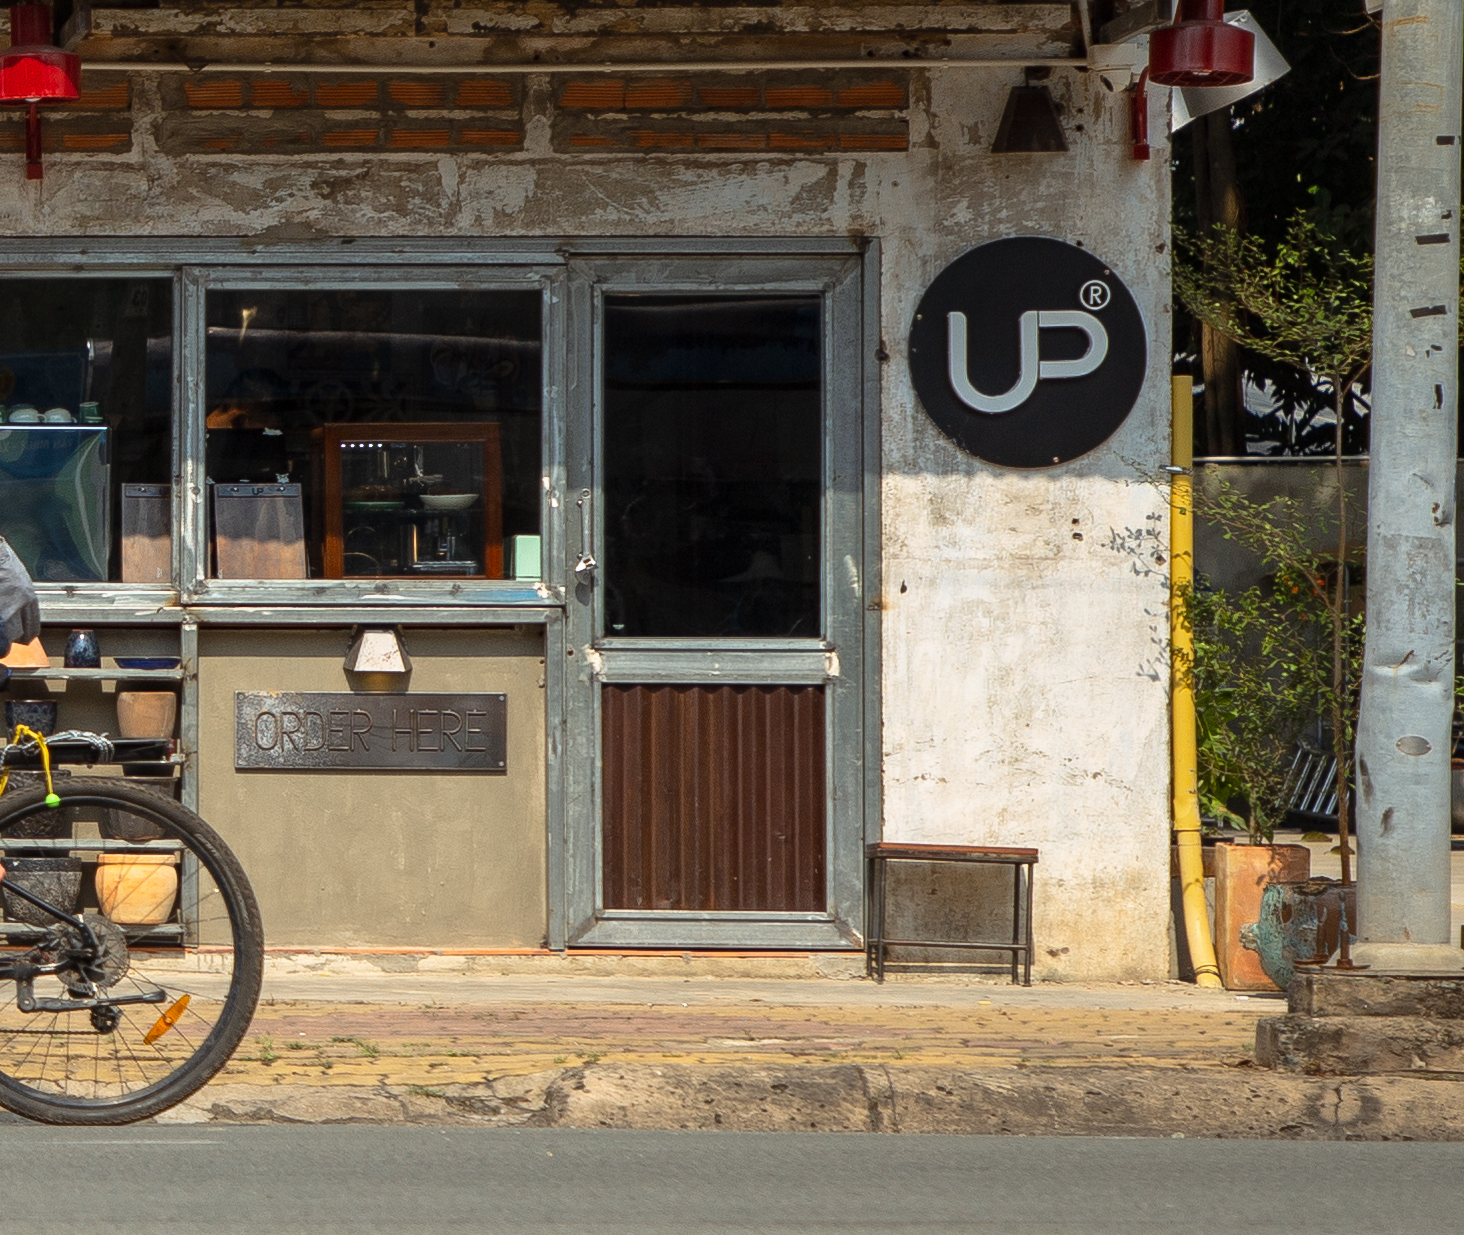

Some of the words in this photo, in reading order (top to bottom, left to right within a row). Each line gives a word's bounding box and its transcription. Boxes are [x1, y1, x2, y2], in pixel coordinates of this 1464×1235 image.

[947, 309, 1109, 414] UP
[254, 708, 373, 752] ORDER
[391, 708, 488, 752] HERE
